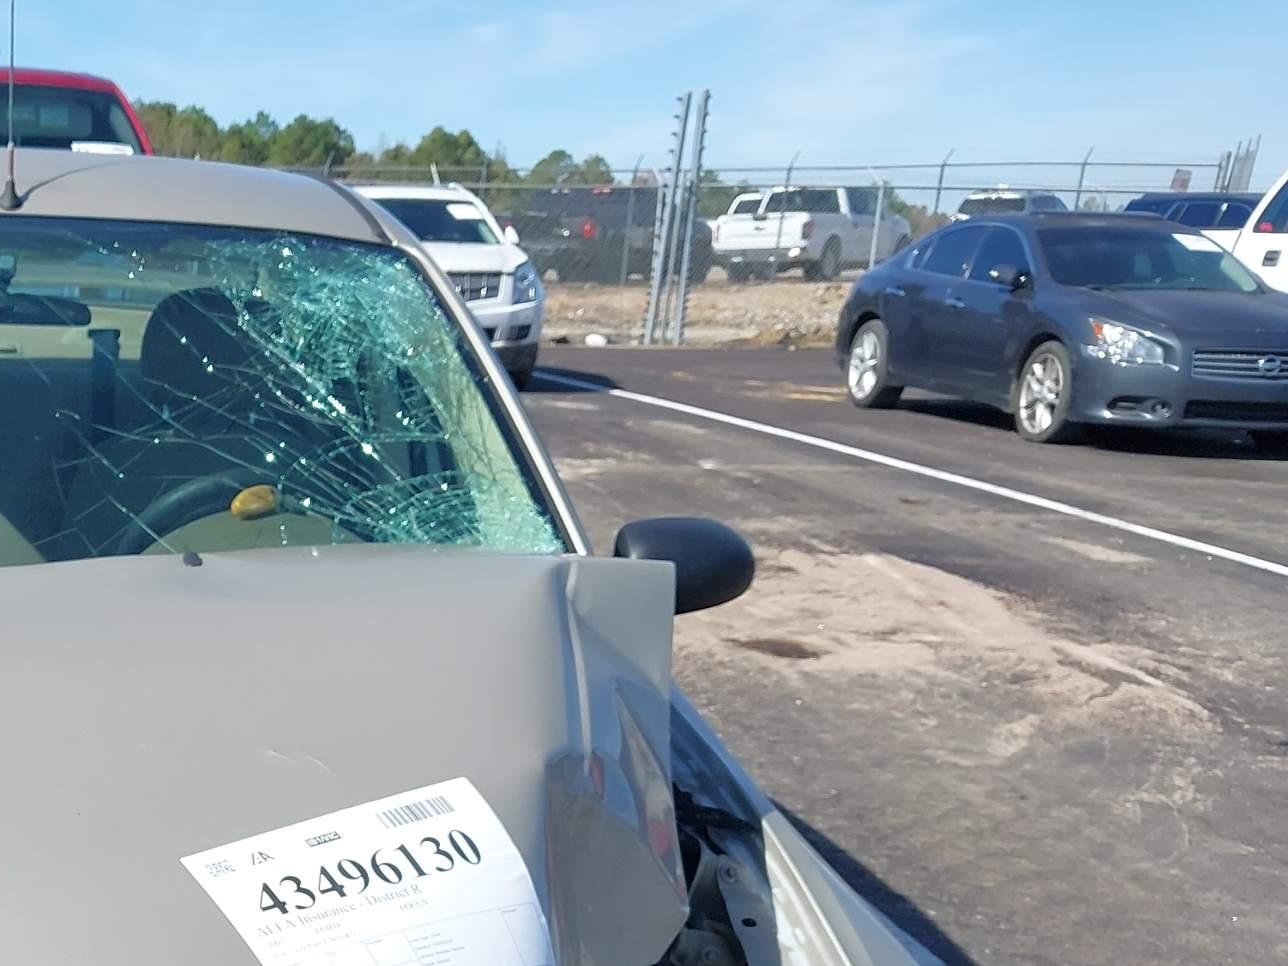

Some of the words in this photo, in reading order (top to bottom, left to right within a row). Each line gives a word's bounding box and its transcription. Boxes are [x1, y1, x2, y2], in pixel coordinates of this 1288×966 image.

[259, 829, 482, 915] 43496130
[297, 902, 357, 925] Insurance
[364, 886, 410, 907] District
